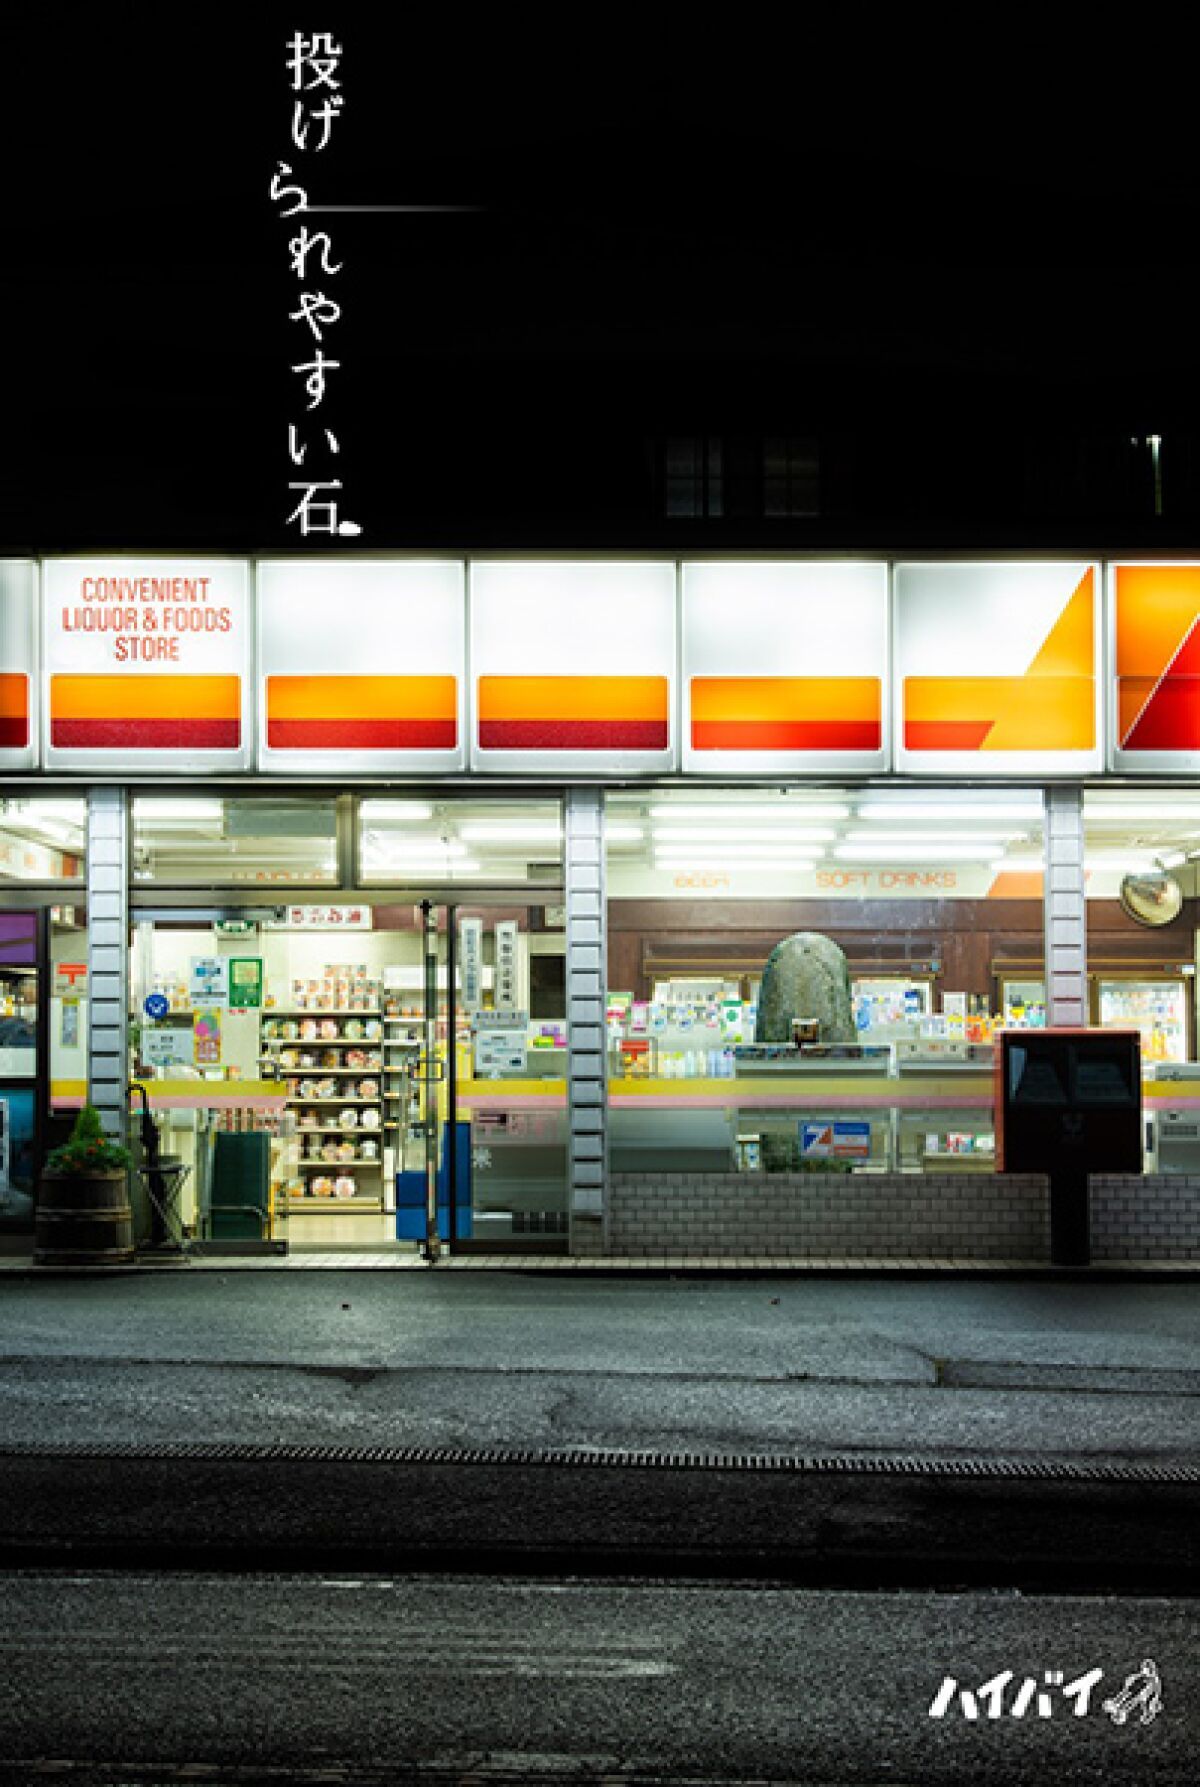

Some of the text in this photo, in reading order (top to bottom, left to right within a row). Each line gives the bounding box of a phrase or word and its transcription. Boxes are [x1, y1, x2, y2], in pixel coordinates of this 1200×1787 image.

[81, 577, 210, 602] CONVENIENT
[62, 607, 232, 632] LIQUOR & FOODS
[114, 637, 180, 662] STORE
[816, 871, 957, 889] SOFT DRINKS
